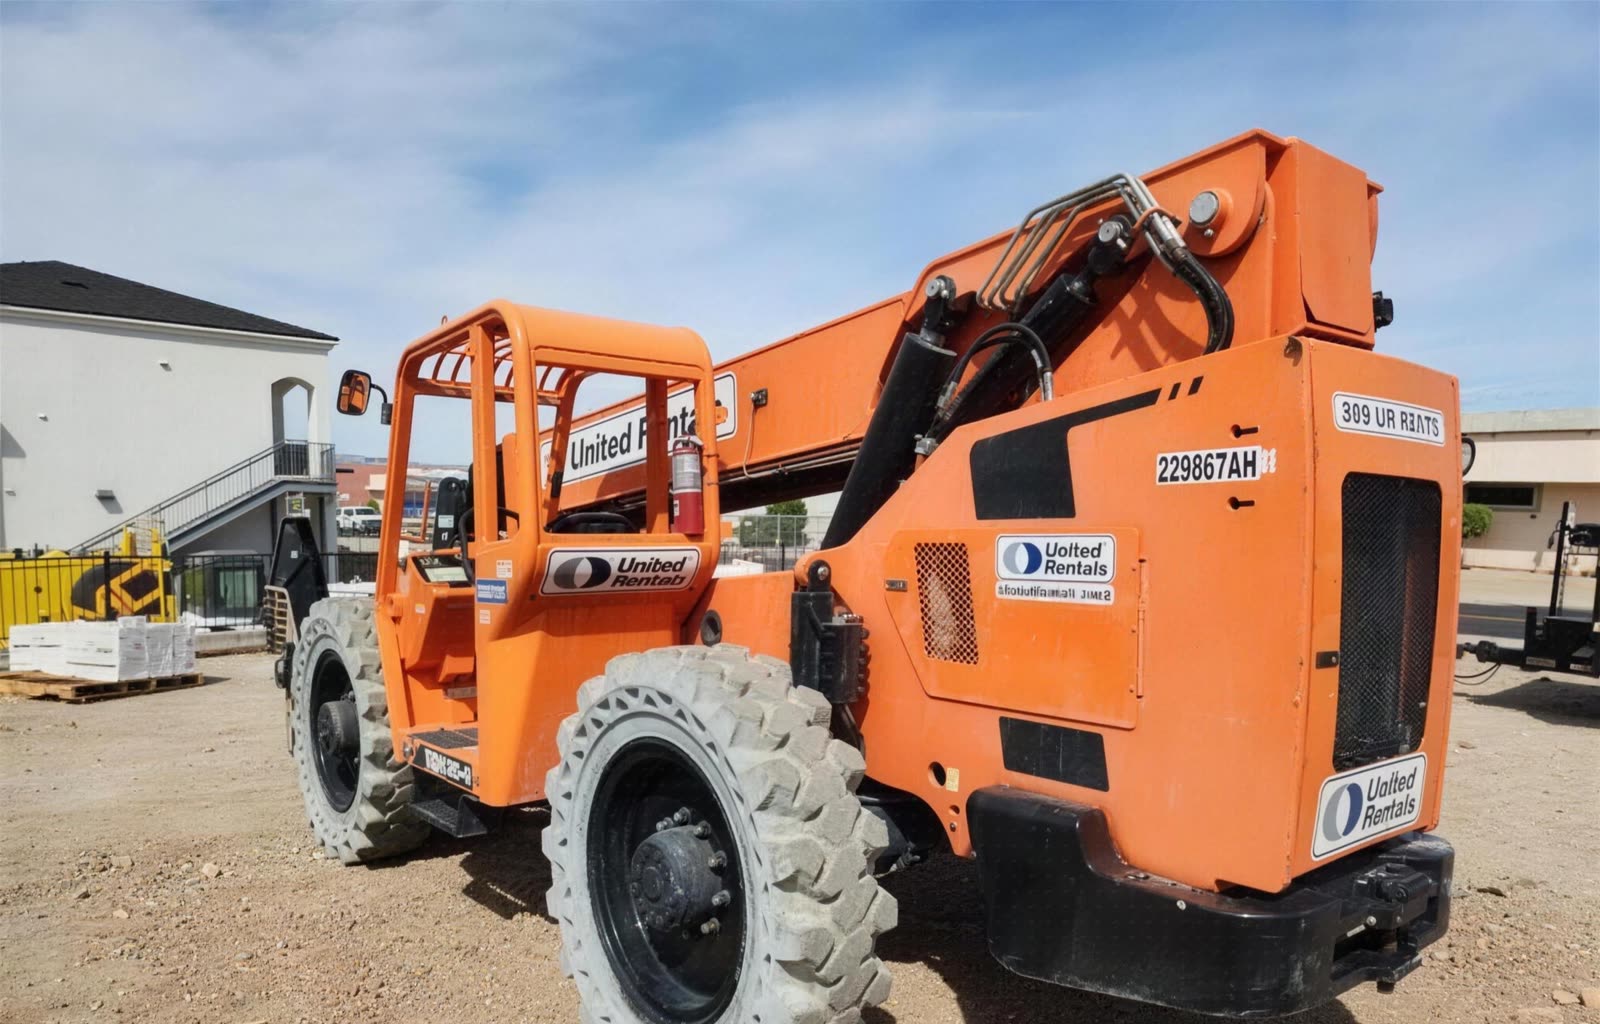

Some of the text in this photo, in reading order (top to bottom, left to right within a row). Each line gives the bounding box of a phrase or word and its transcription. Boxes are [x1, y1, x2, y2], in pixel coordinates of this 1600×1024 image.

[1342, 401, 1371, 426] 309
[1375, 406, 1396, 430] UR
[571, 421, 632, 470] United
[617, 556, 687, 573] United
[1044, 559, 1108, 576] Rentals
